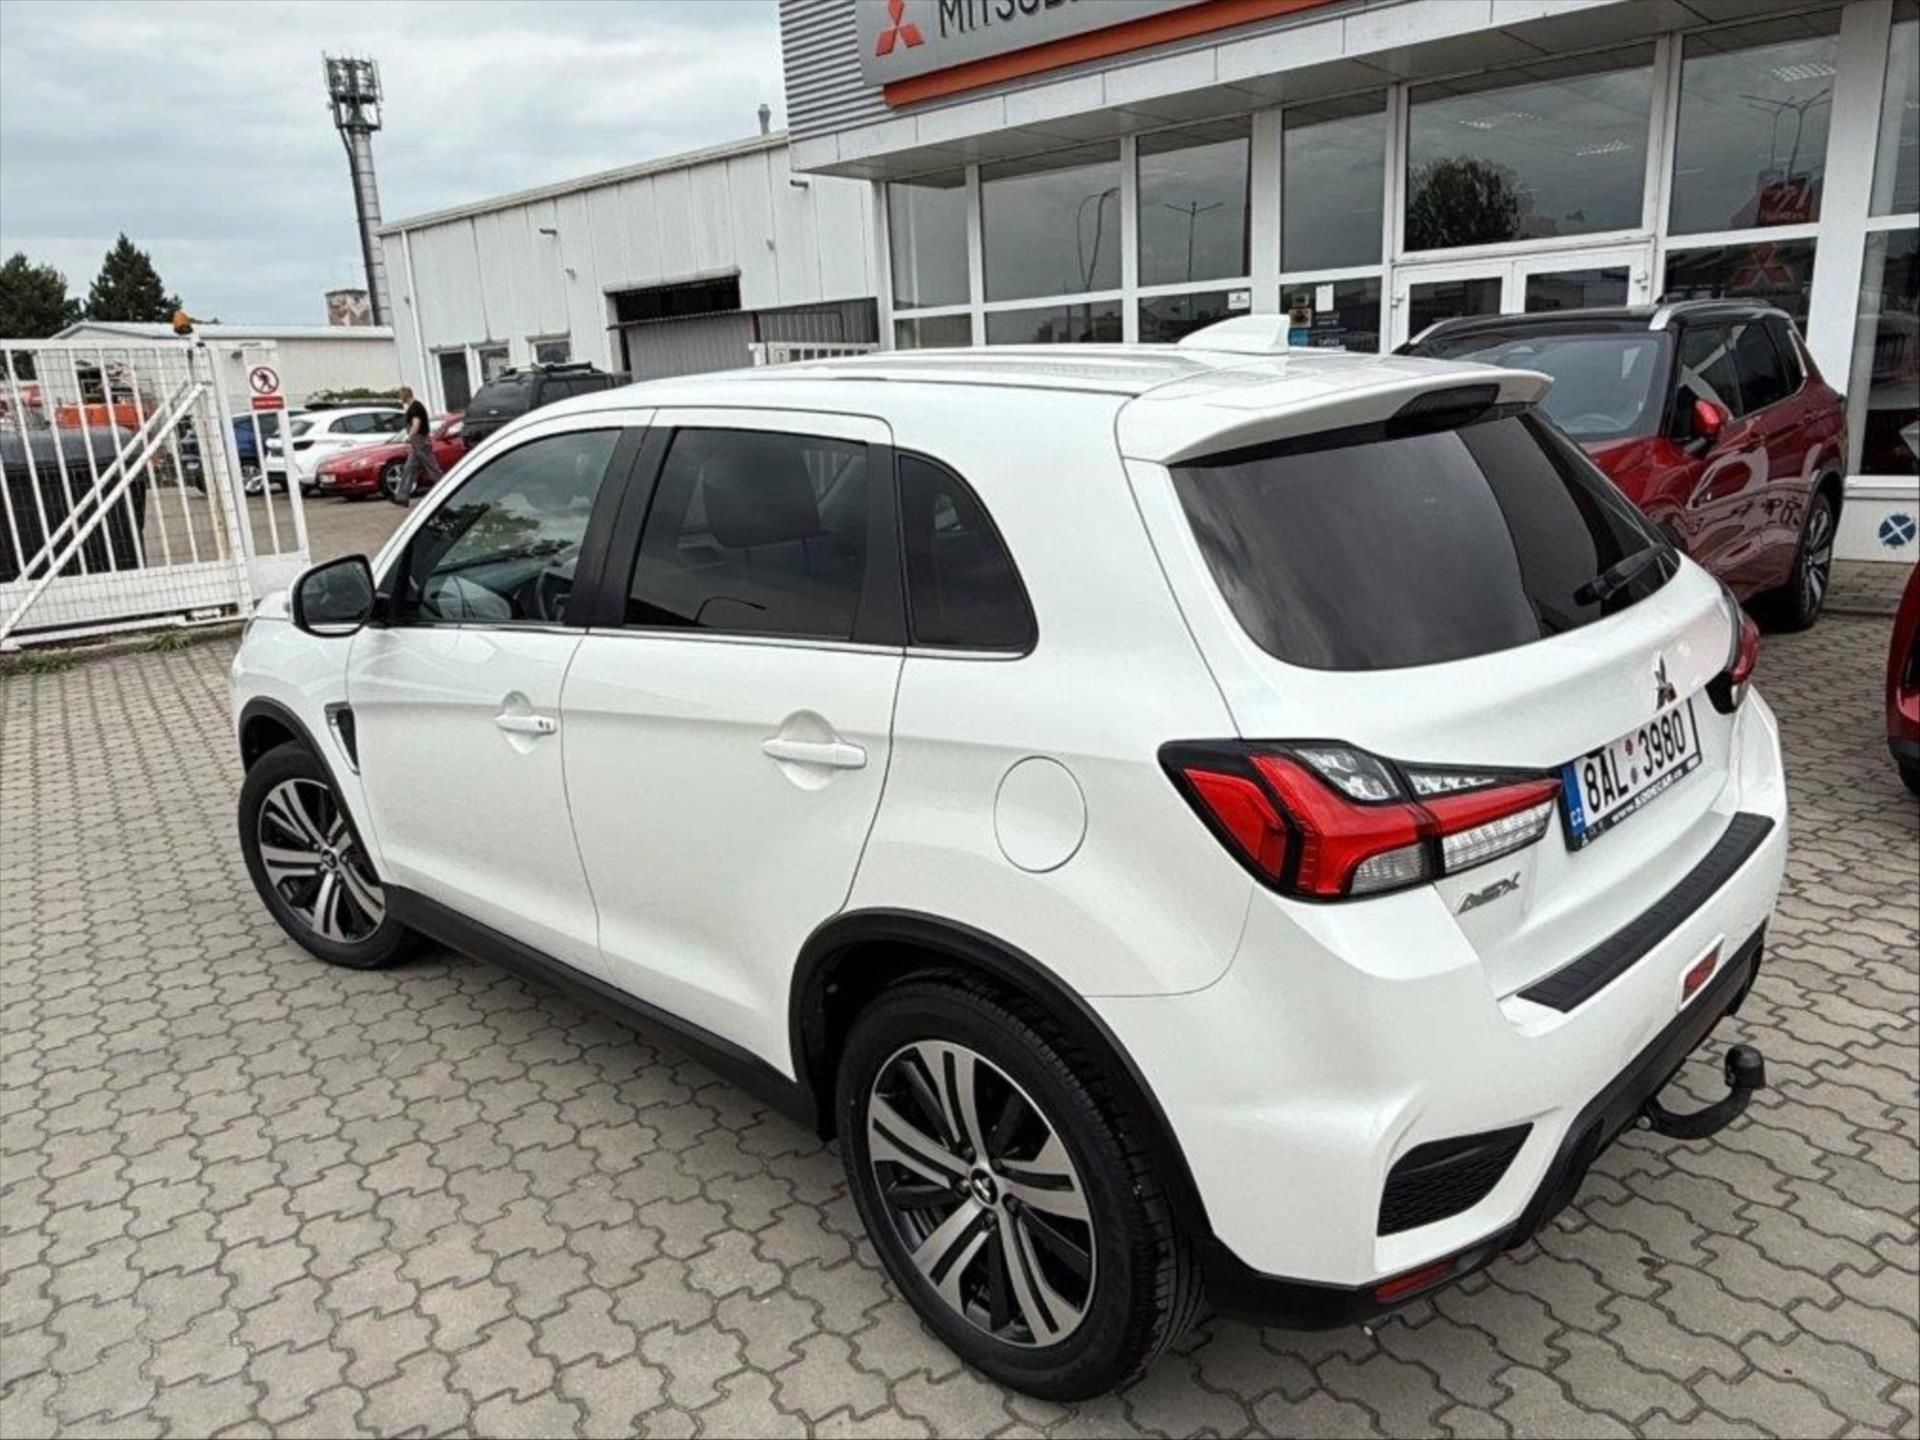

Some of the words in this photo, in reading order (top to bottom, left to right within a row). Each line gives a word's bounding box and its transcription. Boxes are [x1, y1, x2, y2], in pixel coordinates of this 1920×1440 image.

[938, 0, 1067, 38] MITS
[1584, 748, 1629, 813] 8AL
[1638, 709, 1686, 777] 3980
